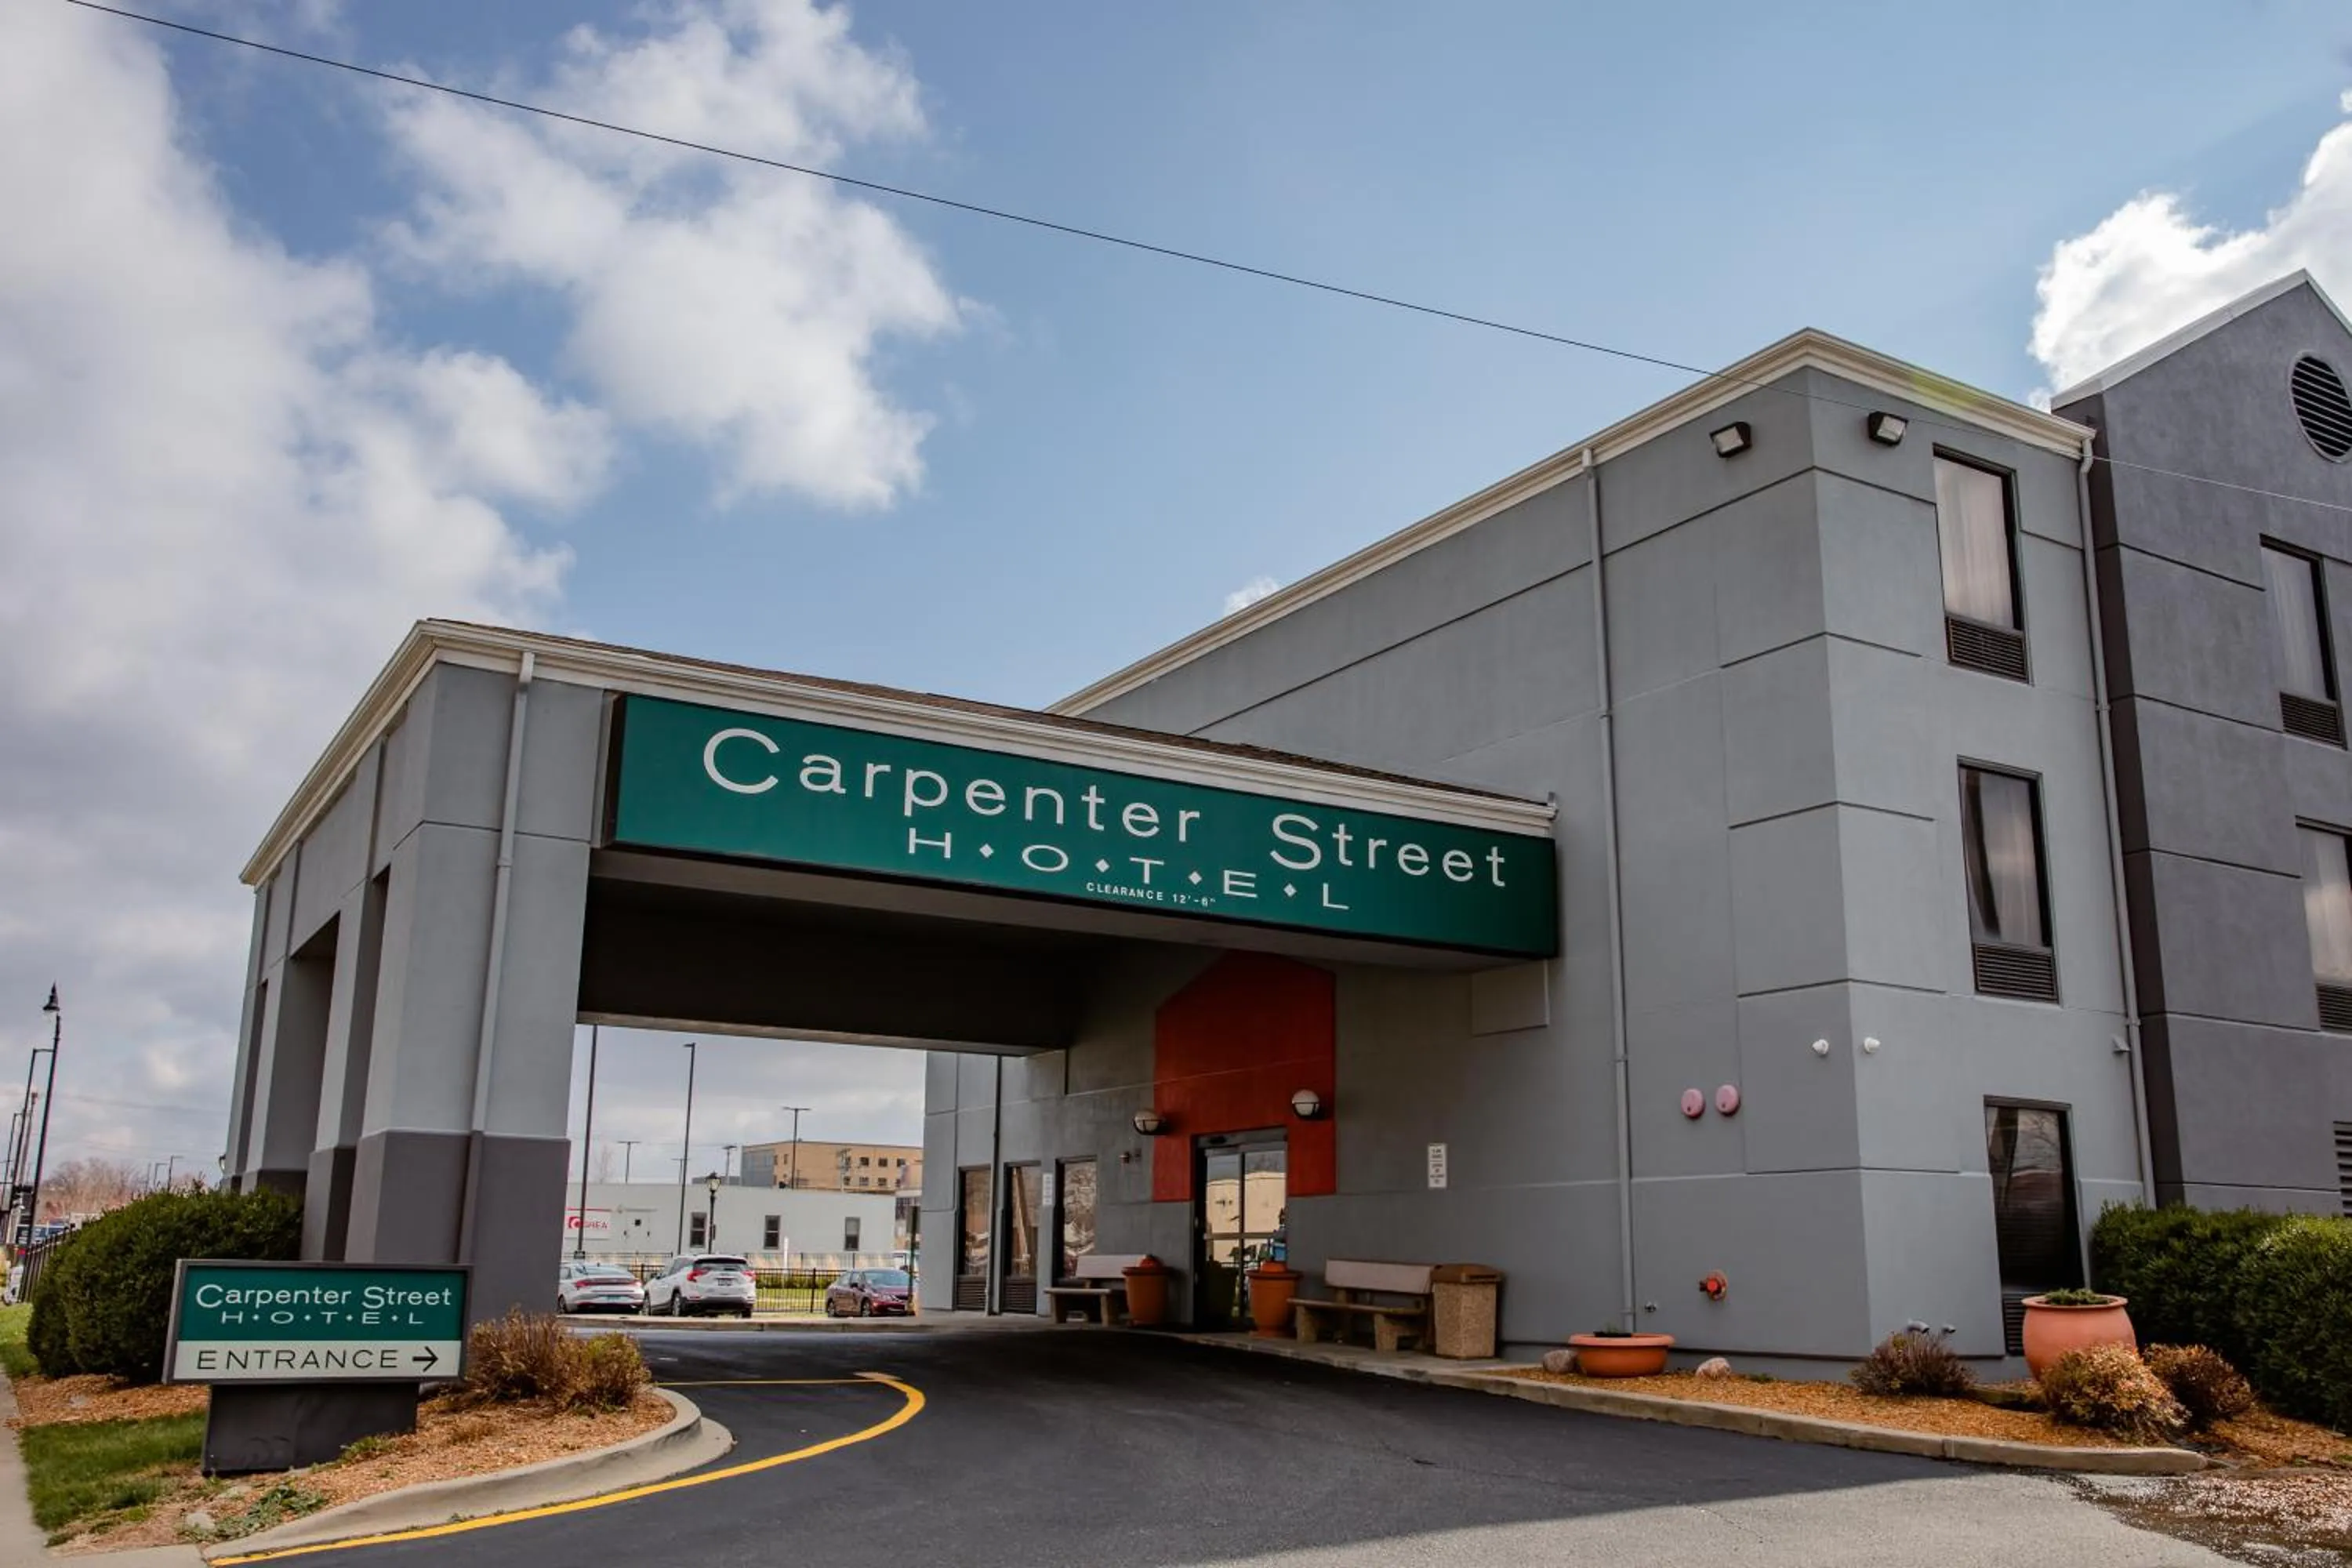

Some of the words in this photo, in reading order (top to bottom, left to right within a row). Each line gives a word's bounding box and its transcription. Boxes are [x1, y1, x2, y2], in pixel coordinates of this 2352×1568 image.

[702, 727, 1201, 843] Carpenter
[1269, 813, 1507, 888] Street
[1086, 881, 1164, 902] CLEARANCE
[195, 1283, 352, 1309] Carpenter
[361, 1286, 452, 1309] Street
[196, 1348, 399, 1370] ENTRANCE
